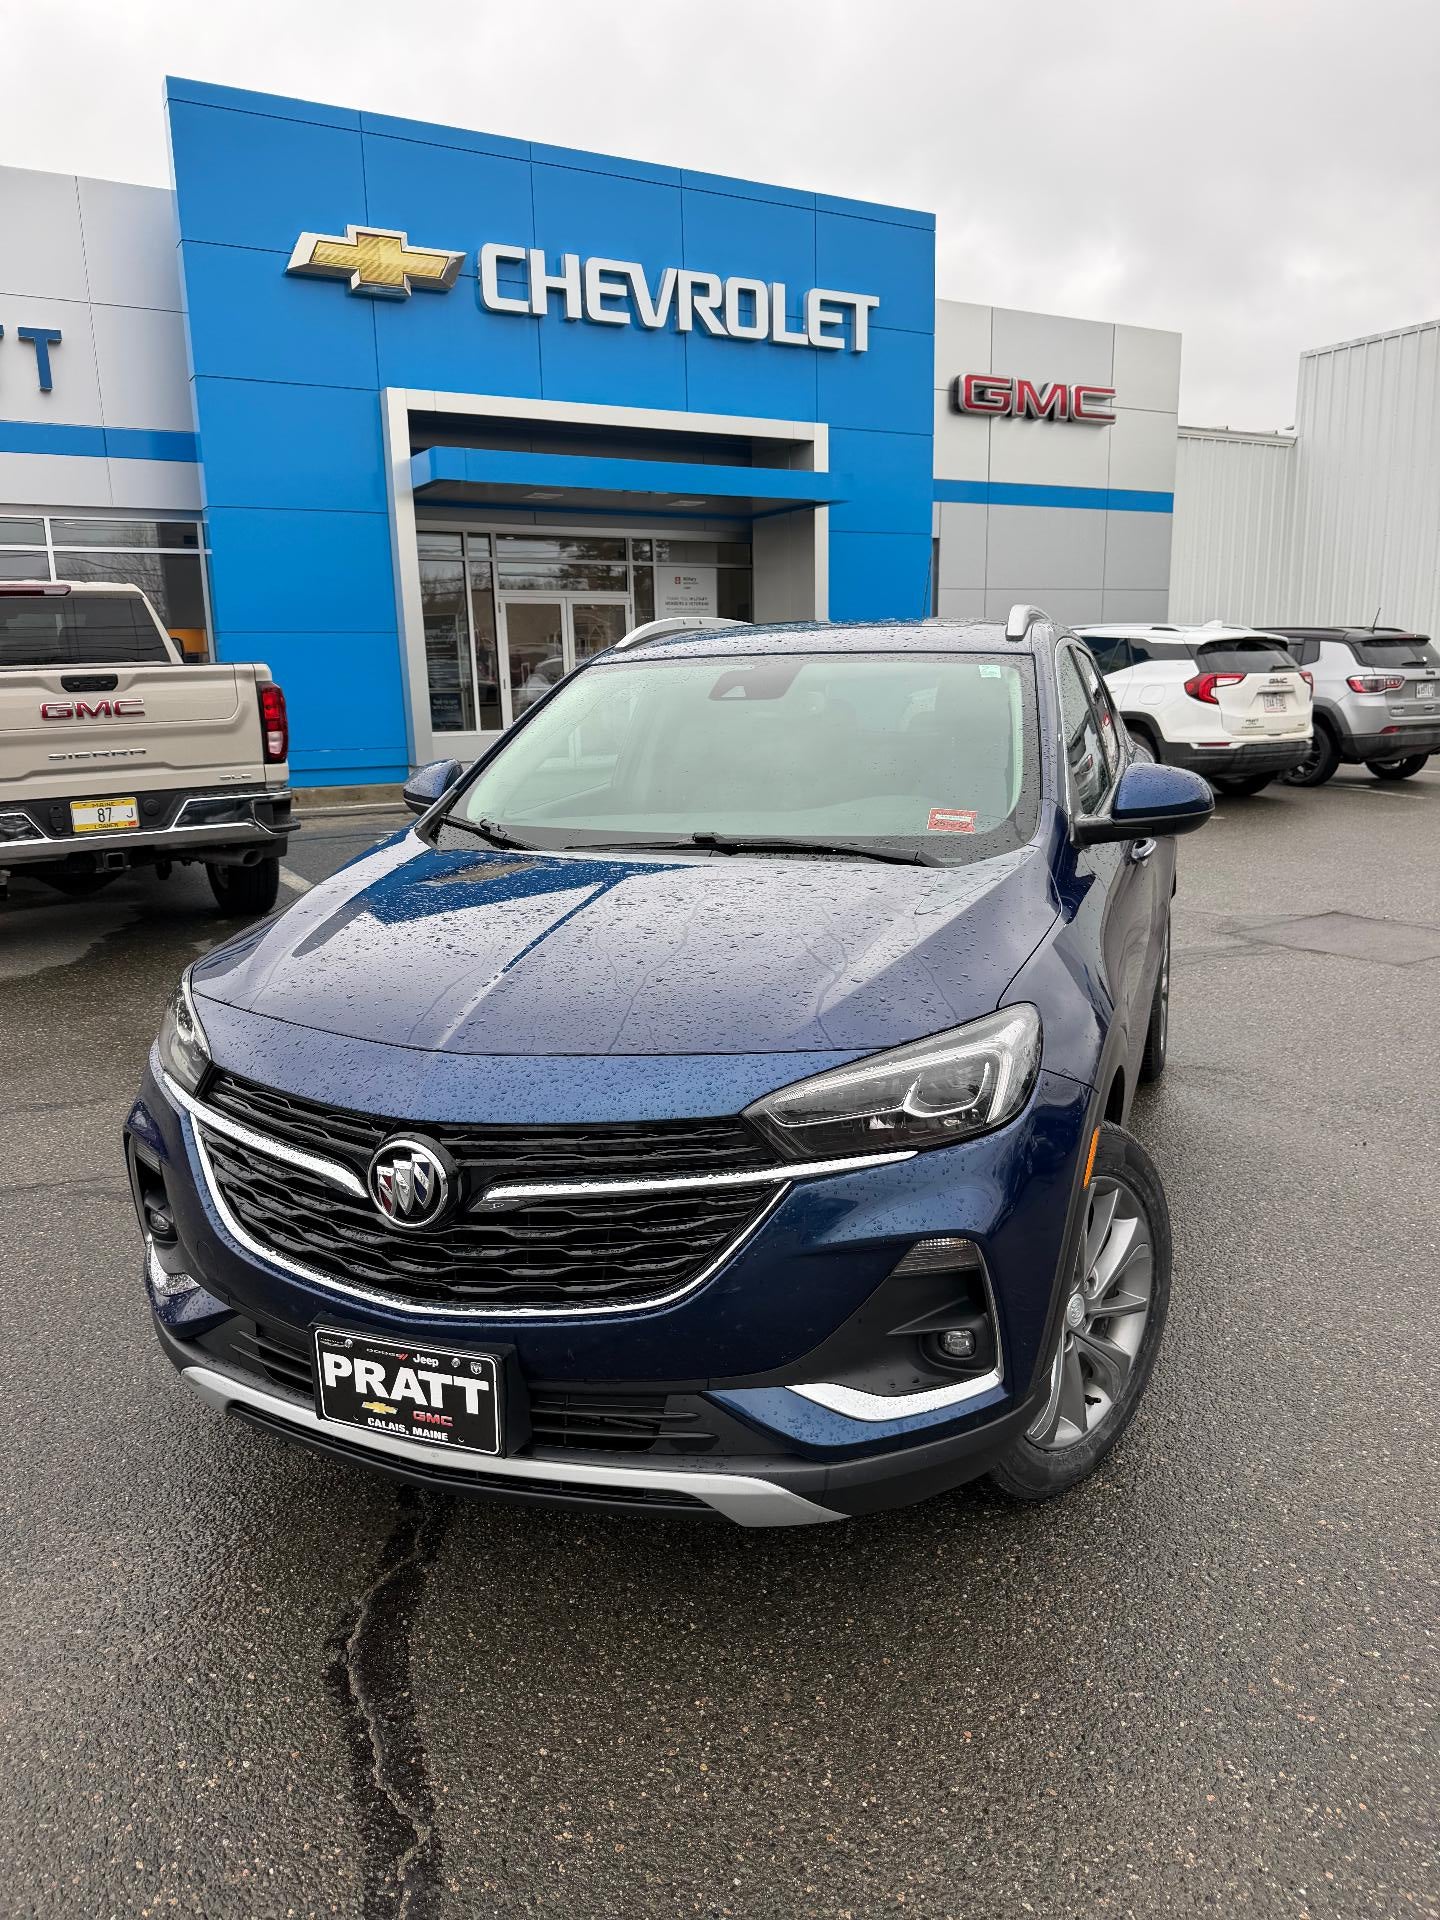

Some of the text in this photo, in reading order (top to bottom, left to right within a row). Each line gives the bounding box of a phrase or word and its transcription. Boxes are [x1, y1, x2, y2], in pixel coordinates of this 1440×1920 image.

[478, 241, 880, 353] CHEVROLET
[955, 372, 1117, 425] GMC
[40, 698, 146, 721] GMC
[48, 748, 147, 761] SIERRA
[97, 807, 134, 822] 87 J
[412, 1353, 439, 1368] Jeep
[322, 1351, 490, 1415] PRATT
[367, 1416, 449, 1441] CALAIS, MAINE
[412, 1410, 454, 1427] GMC
